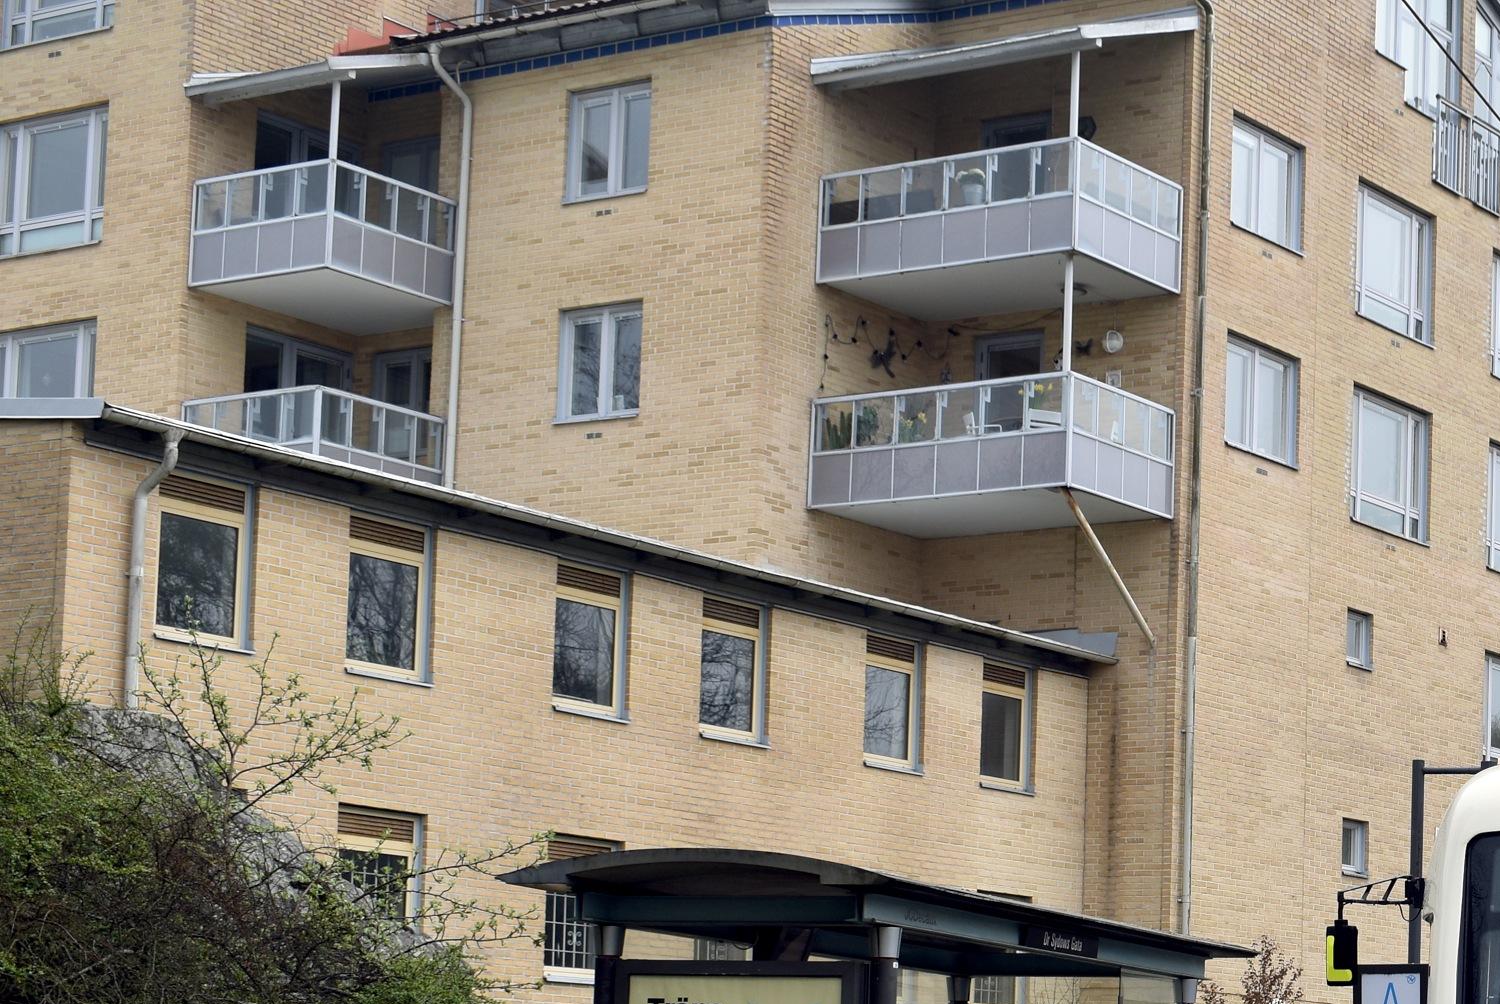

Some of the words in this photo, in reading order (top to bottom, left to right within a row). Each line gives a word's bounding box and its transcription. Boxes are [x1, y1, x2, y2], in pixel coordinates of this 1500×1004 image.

[1043, 931, 1051, 947] Dr
[1051, 933, 1071, 951] Sydows
[1071, 937, 1083, 952] Gata
